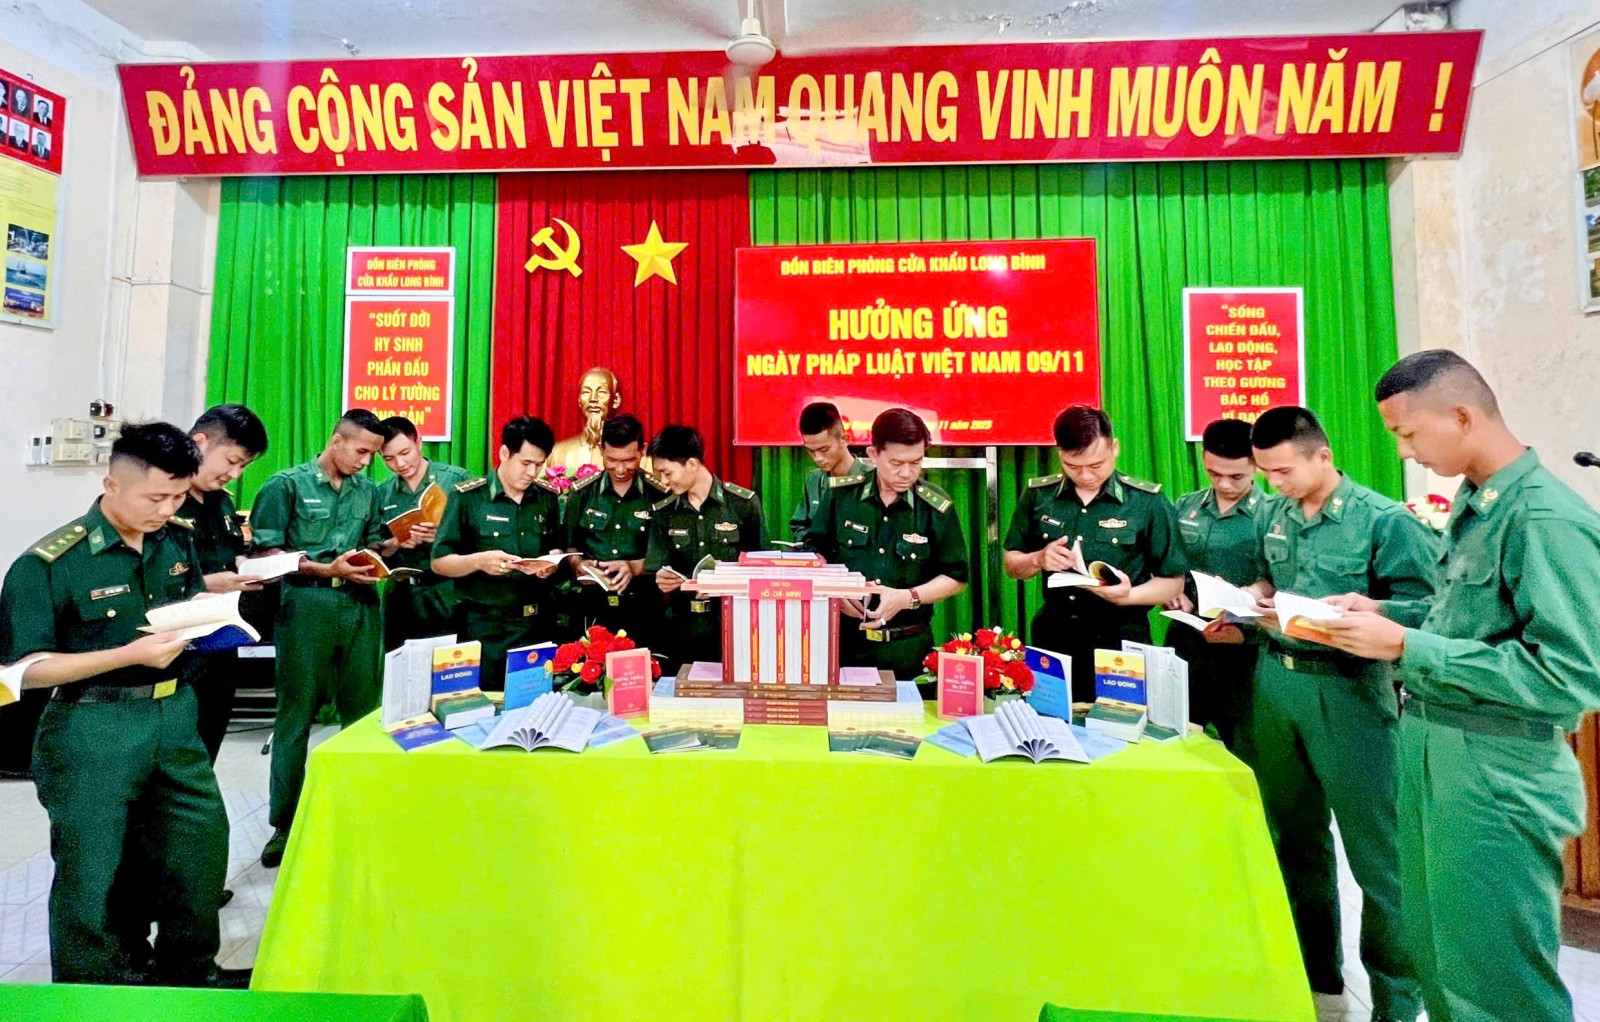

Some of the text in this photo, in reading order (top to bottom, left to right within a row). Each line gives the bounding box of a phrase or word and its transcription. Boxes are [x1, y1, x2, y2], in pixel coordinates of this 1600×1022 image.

[145, 47, 1453, 166] ĐẢNG CỘNG SẢN VIỆT NAM QUANG VINH MUÔN NĂM !
[386, 257, 406, 270] BIÊN
[407, 257, 437, 270] PHÒNG
[812, 257, 845, 275] BIÊN
[847, 255, 895, 274] PHÒNG
[897, 253, 927, 273] CỬA
[929, 251, 968, 272] KHẨU
[970, 255, 1008, 272] LONG
[1010, 253, 1046, 271] BÌNH
[357, 272, 445, 288] CỬA KHẨU LONG BÌNH
[409, 308, 431, 328] ĐỜI
[829, 298, 1008, 340] HƯỞNG ỨNG
[1205, 321, 1246, 336] CHIẾN
[374, 337, 424, 352] HY SINH
[1208, 341, 1234, 354] LAO
[367, 356, 429, 377] PHẤN ĐẤU
[746, 347, 1084, 379] NGÀY PHÁP LUẬT VIỆT NAM 09/11
[1215, 357, 1273, 373] HỌC TẬP
[354, 380, 441, 401] CHO LÝ TƯỞNG
[1203, 376, 1286, 389] THEO GƯƠNG
[1220, 392, 1247, 406] BÁC
